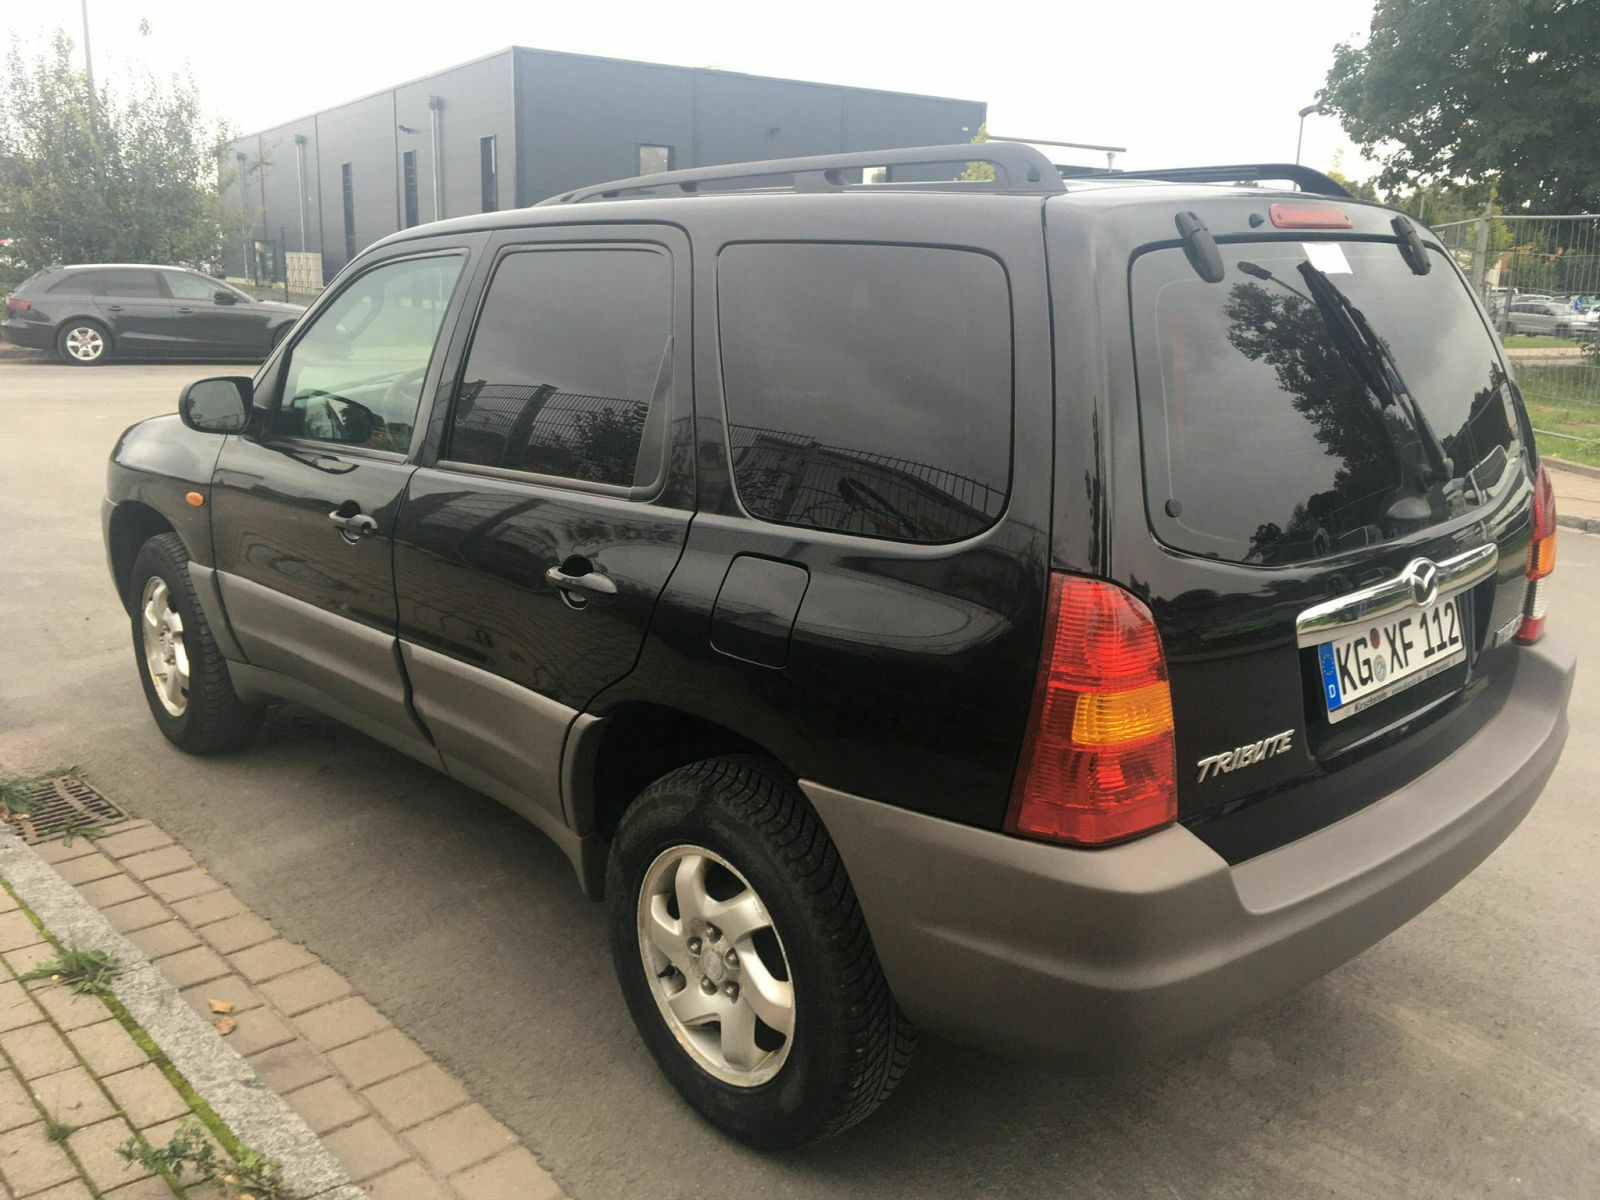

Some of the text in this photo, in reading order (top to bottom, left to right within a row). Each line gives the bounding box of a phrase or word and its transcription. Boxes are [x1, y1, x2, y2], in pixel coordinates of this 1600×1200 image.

[1336, 637, 1374, 695] KG
[1384, 618, 1414, 674] XF
[1419, 602, 1459, 658] 112
[1328, 684, 1336, 698] D
[1197, 728, 1295, 784] TRIBUTE
